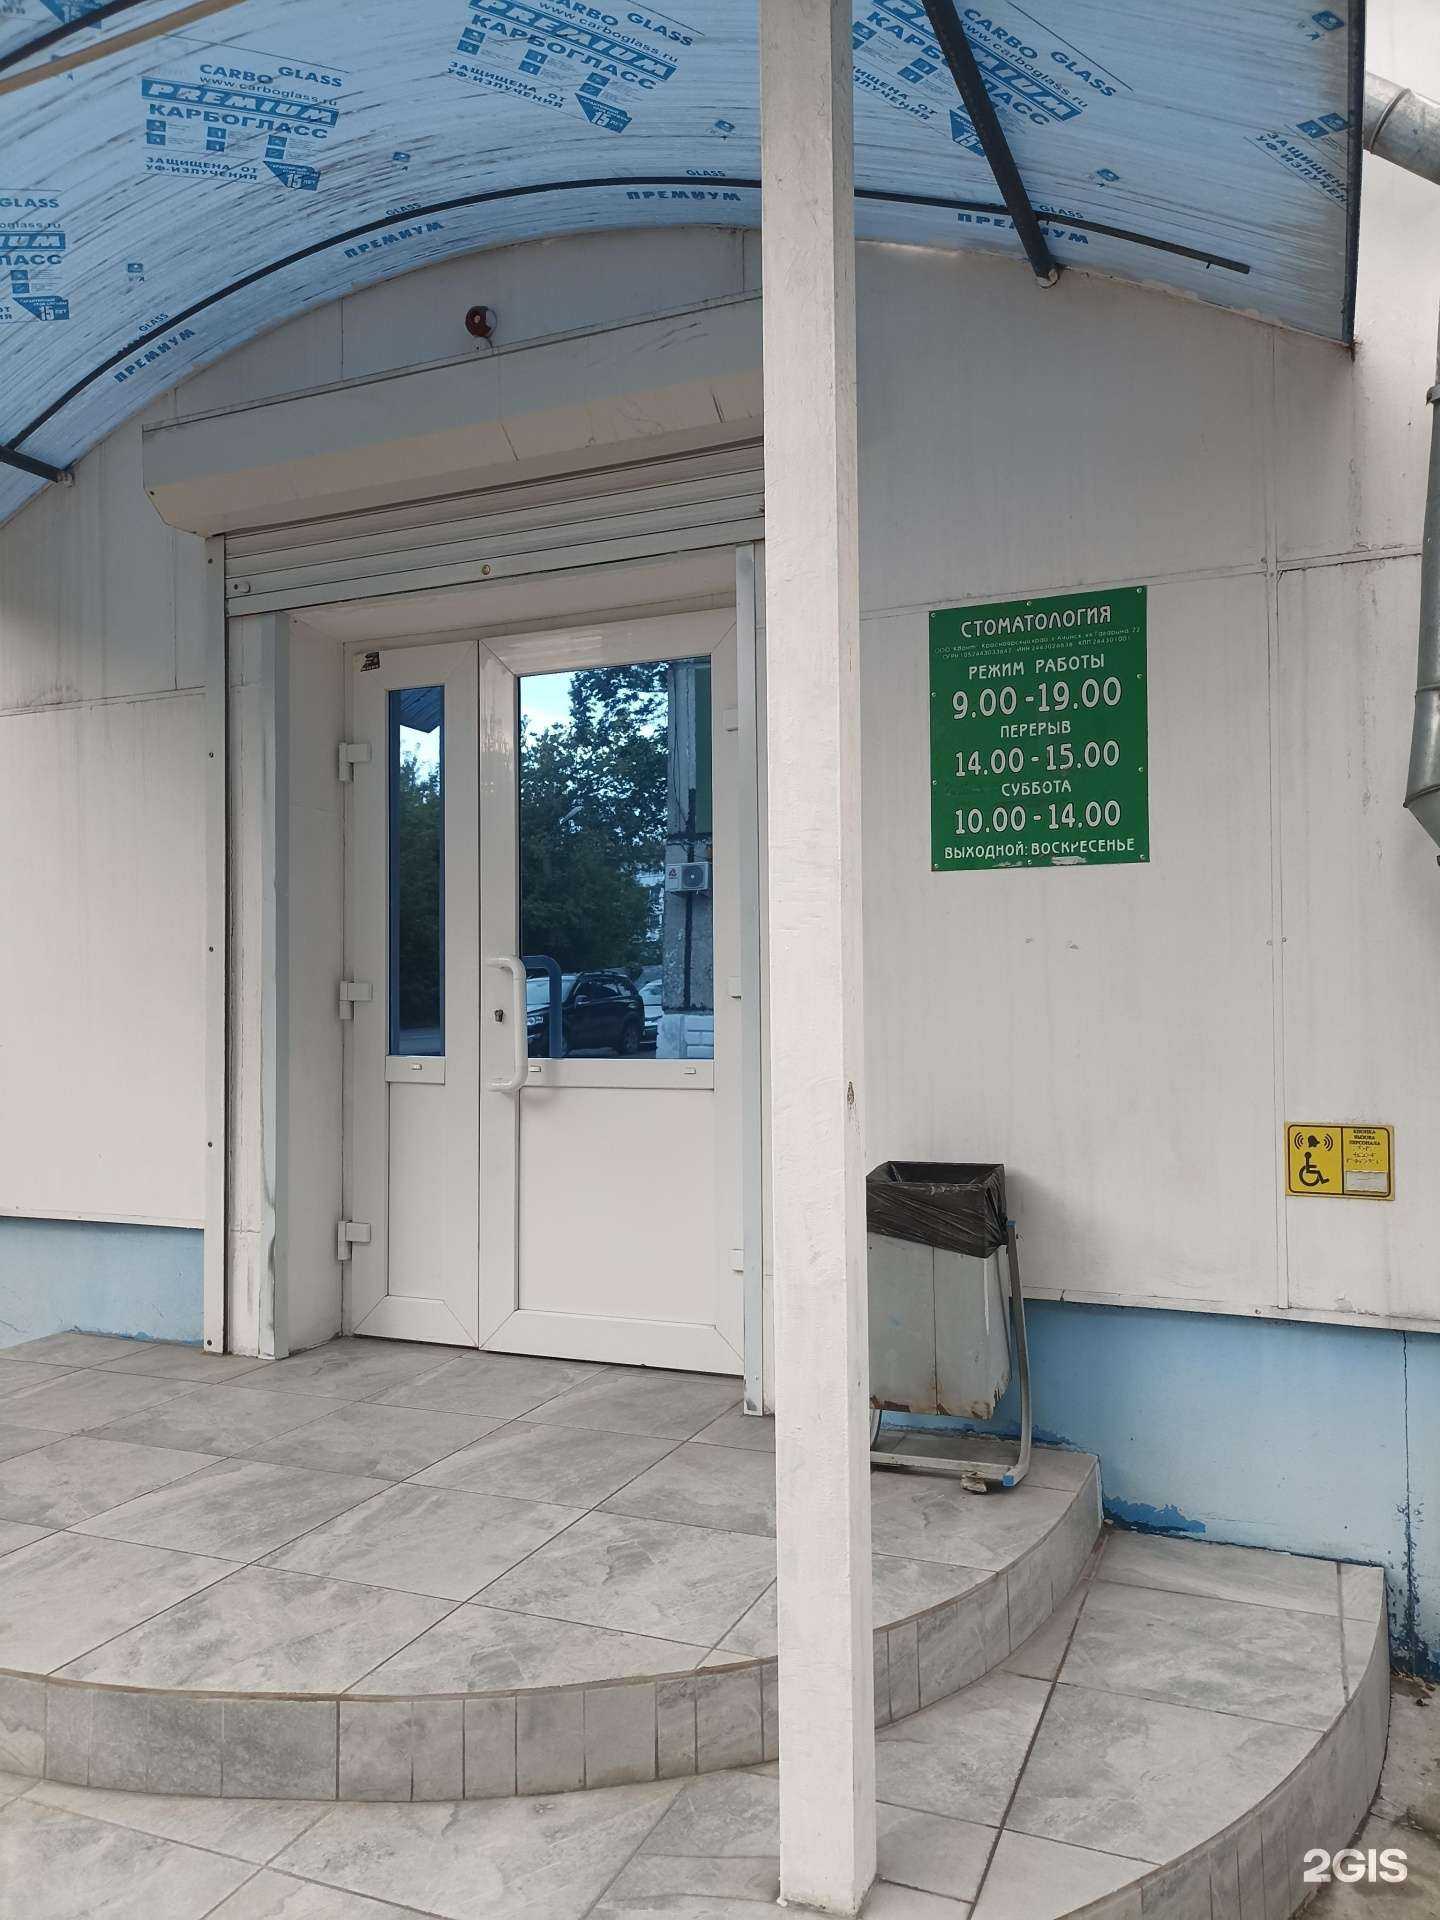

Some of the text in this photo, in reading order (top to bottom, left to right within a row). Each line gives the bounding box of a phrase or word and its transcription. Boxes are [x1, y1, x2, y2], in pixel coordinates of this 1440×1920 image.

[539, 2, 679, 63] www.carboglass.ru
[554, 0, 693, 46] ARBO GLASS
[471, 14, 657, 90] КАРБОГЛАСС
[963, 8, 1117, 97] CARBO GLASS
[199, 63, 342, 88] CARBO GLASS
[199, 76, 338, 107] www.carboglass.ru
[450, 61, 537, 93] ЗАЩИЩЕНА
[148, 82, 332, 127] PREMIUM
[149, 103, 328, 139] КАРБОГЛАСС
[146, 156, 231, 171] ЗАЩИЩЕНА
[685, 168, 727, 177] GLASS
[625, 190, 742, 202] ПРЕМИУМ
[1038, 204, 1085, 220] GLASS
[343, 221, 445, 259] ПРЕМИУМ
[138, 312, 169, 332] GLASS
[113, 328, 196, 383] ПРЕМИУМ
[960, 605, 1111, 638] СТОМАТОЛОГИЯ
[968, 653, 1105, 680] РЕЖИМ РАБОТЫ
[952, 686, 1017, 720] 9.00
[1038, 676, 1122, 713] 19.00
[1000, 720, 1071, 738] ПЕРЕРЫВ
[955, 747, 1024, 777] 14.00
[1046, 740, 1120, 771] 15.00
[1001, 779, 1072, 797] СУББОТА
[955, 805, 1026, 834] 10.00
[1048, 800, 1121, 830] 14.00
[944, 838, 1135, 859] ВЫХОДНОЙ: ВОСКРЕСЕНЬЕ
